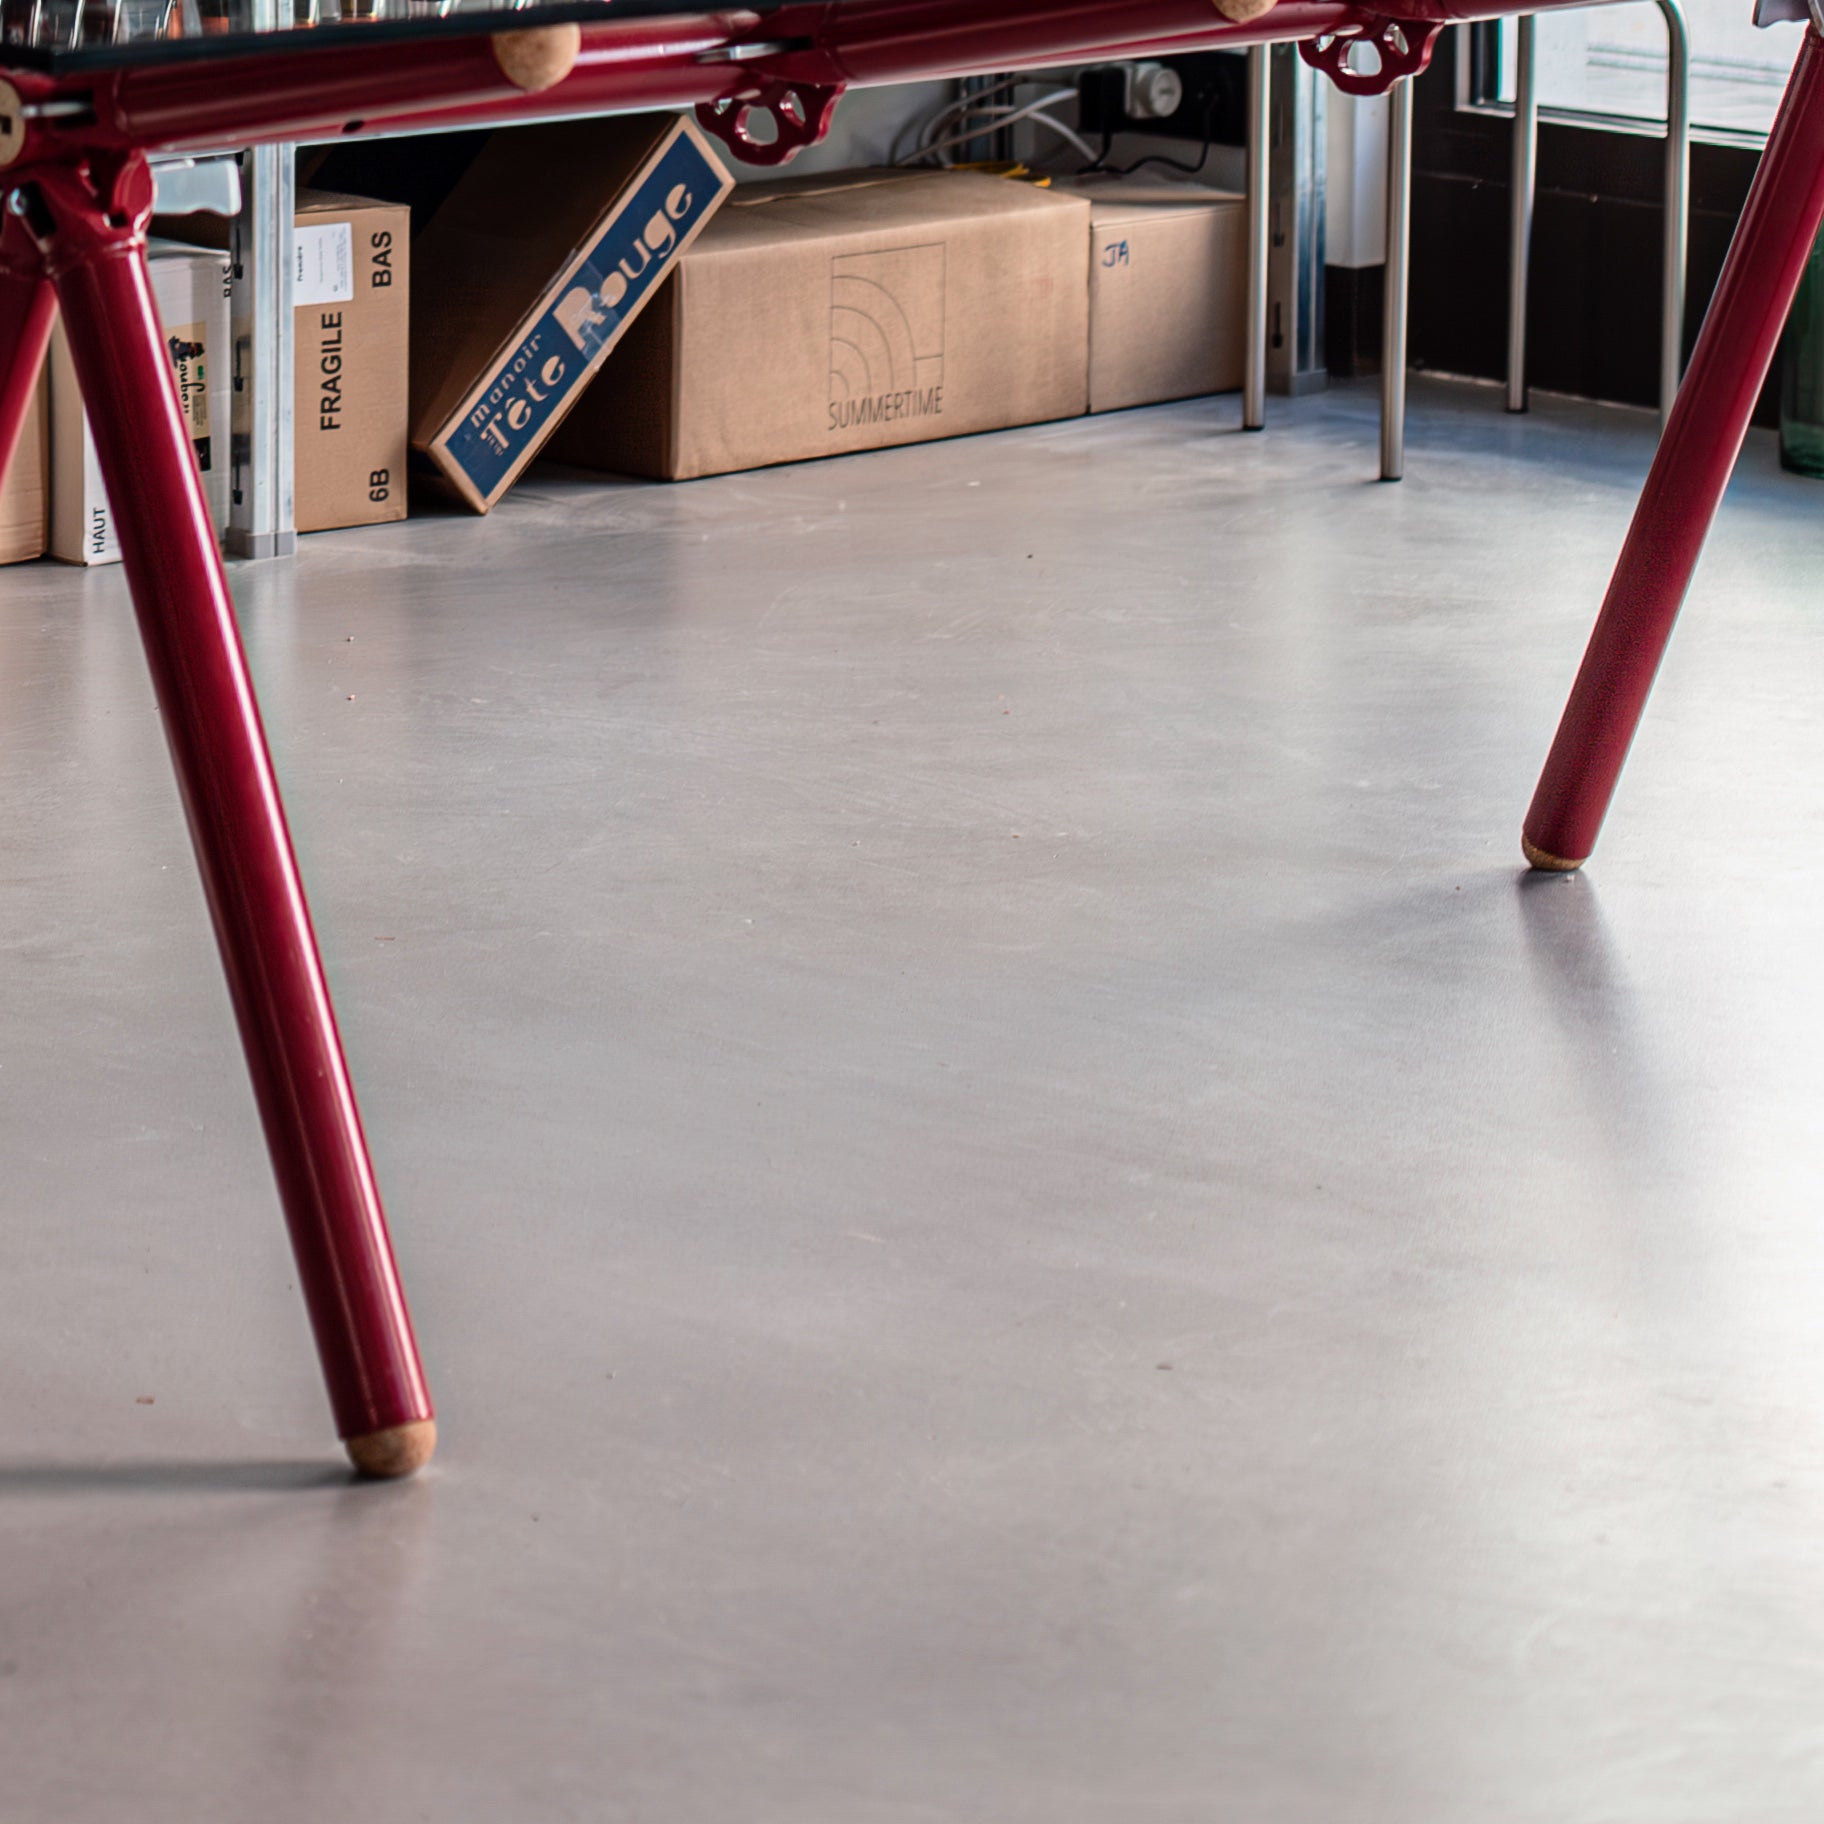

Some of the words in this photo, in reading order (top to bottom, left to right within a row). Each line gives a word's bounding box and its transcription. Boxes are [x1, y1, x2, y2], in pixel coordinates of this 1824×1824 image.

[371, 230, 392, 288] BAS
[480, 355, 566, 450] Tête
[552, 183, 693, 351] Rouge
[320, 311, 342, 431] FRAGILE
[470, 334, 542, 429] manoir
[828, 386, 944, 431] SUMMERTIME
[369, 467, 390, 502] 6B
[92, 508, 106, 554] HAUT
